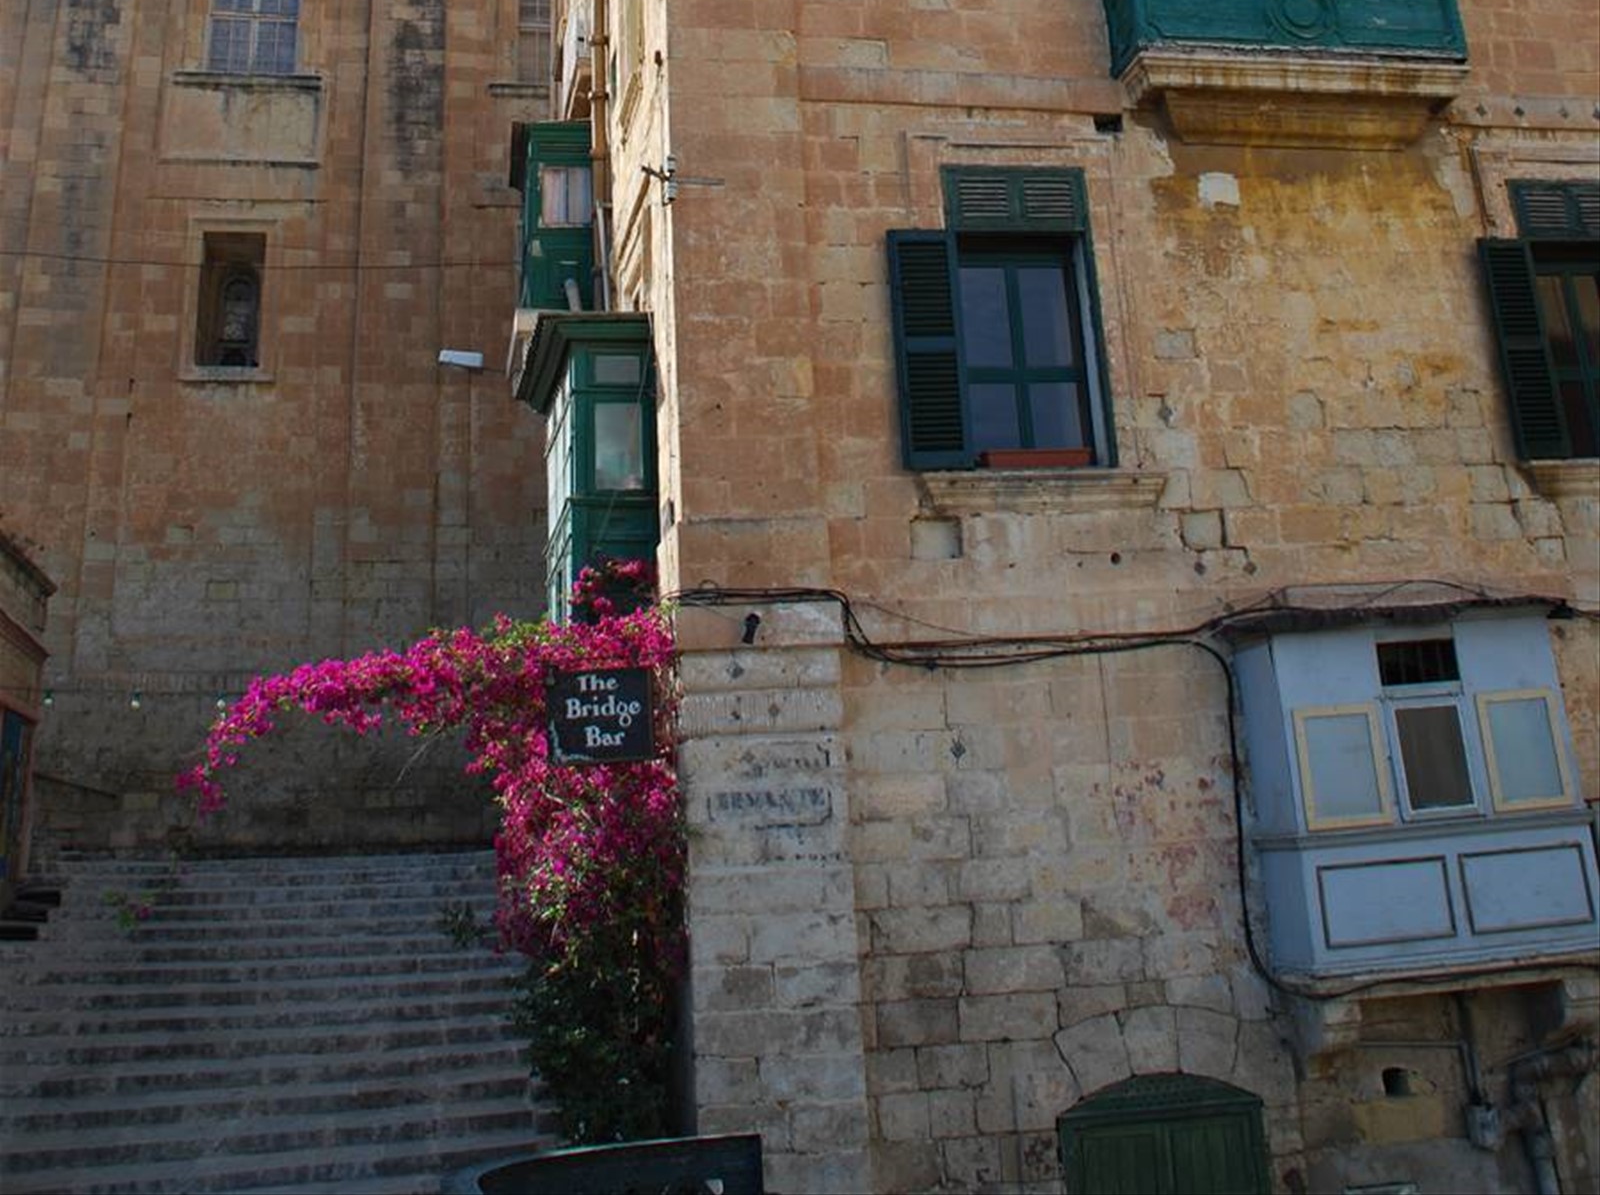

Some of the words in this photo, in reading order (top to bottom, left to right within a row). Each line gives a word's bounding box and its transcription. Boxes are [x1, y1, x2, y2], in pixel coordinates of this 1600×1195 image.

[577, 674, 619, 692] The
[565, 695, 641, 727] Bridge
[584, 725, 626, 747] Bar
